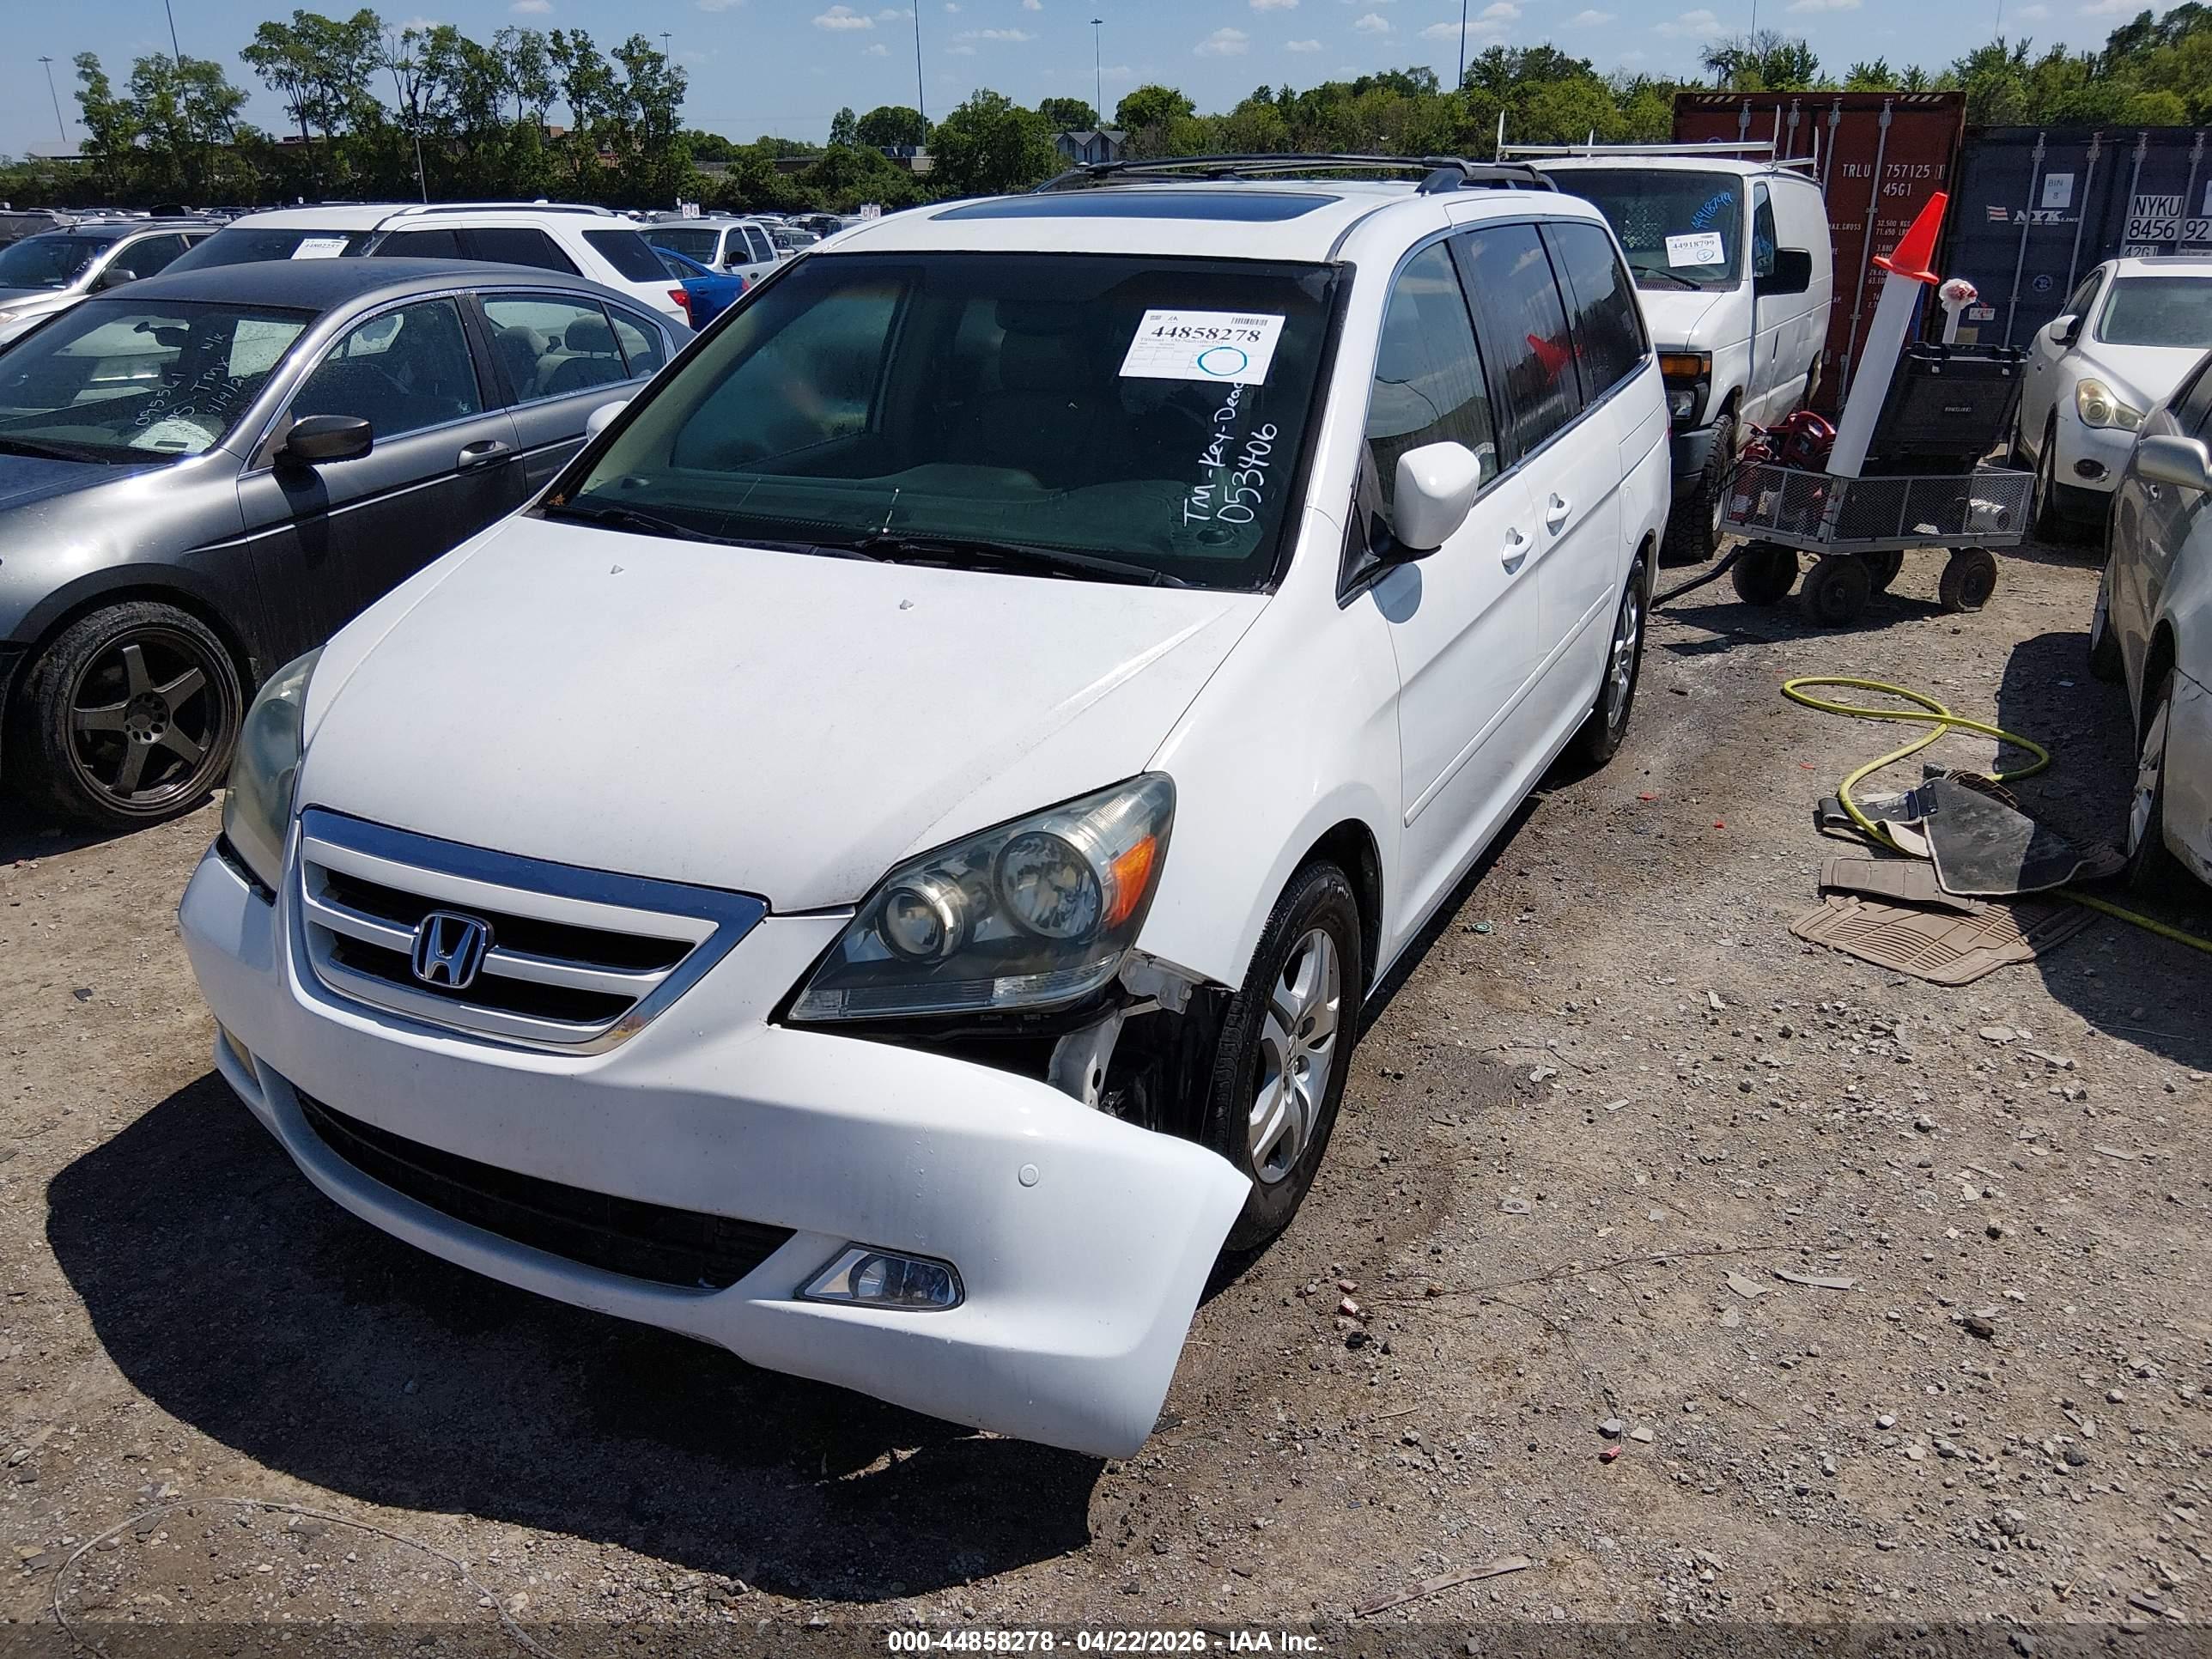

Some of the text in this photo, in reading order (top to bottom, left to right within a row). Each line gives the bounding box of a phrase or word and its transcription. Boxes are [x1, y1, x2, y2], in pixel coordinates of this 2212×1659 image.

[1842, 163, 1871, 178] TRLU
[1887, 164, 1930, 178] 757125
[1883, 183, 1911, 197] 45G1
[2133, 196, 2182, 216] NYKU
[2129, 219, 2210, 240] 8456 92
[1151, 325, 1262, 343] 44858278
[1216, 423, 1278, 524] 053406
